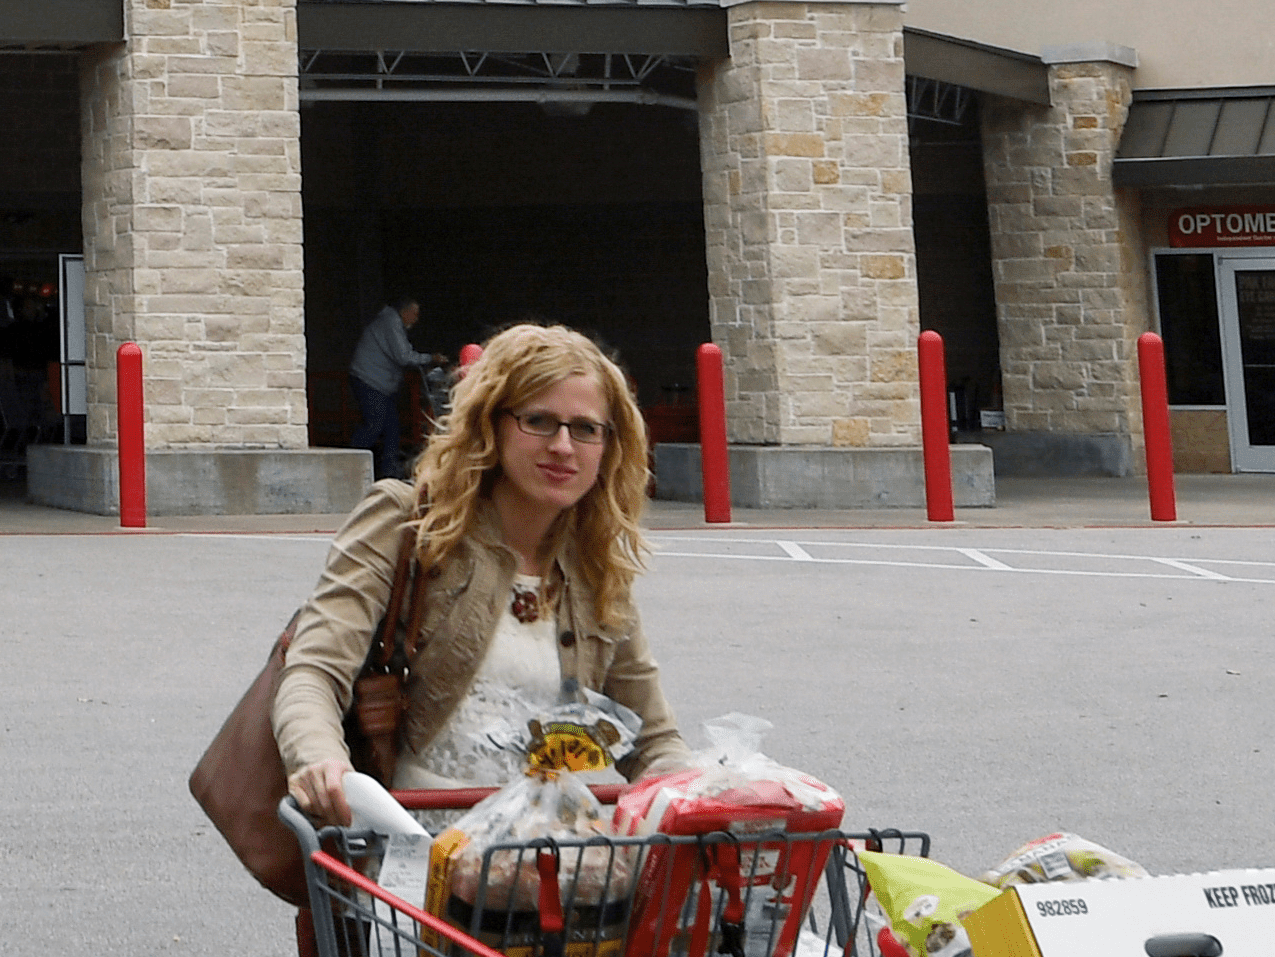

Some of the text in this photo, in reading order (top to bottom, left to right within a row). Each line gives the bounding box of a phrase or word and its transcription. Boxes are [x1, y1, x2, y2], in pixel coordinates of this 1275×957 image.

[1178, 213, 1275, 234] OPTOME
[1203, 883, 1275, 909] KEEP FROZ
[1036, 898, 1089, 918] 982859
